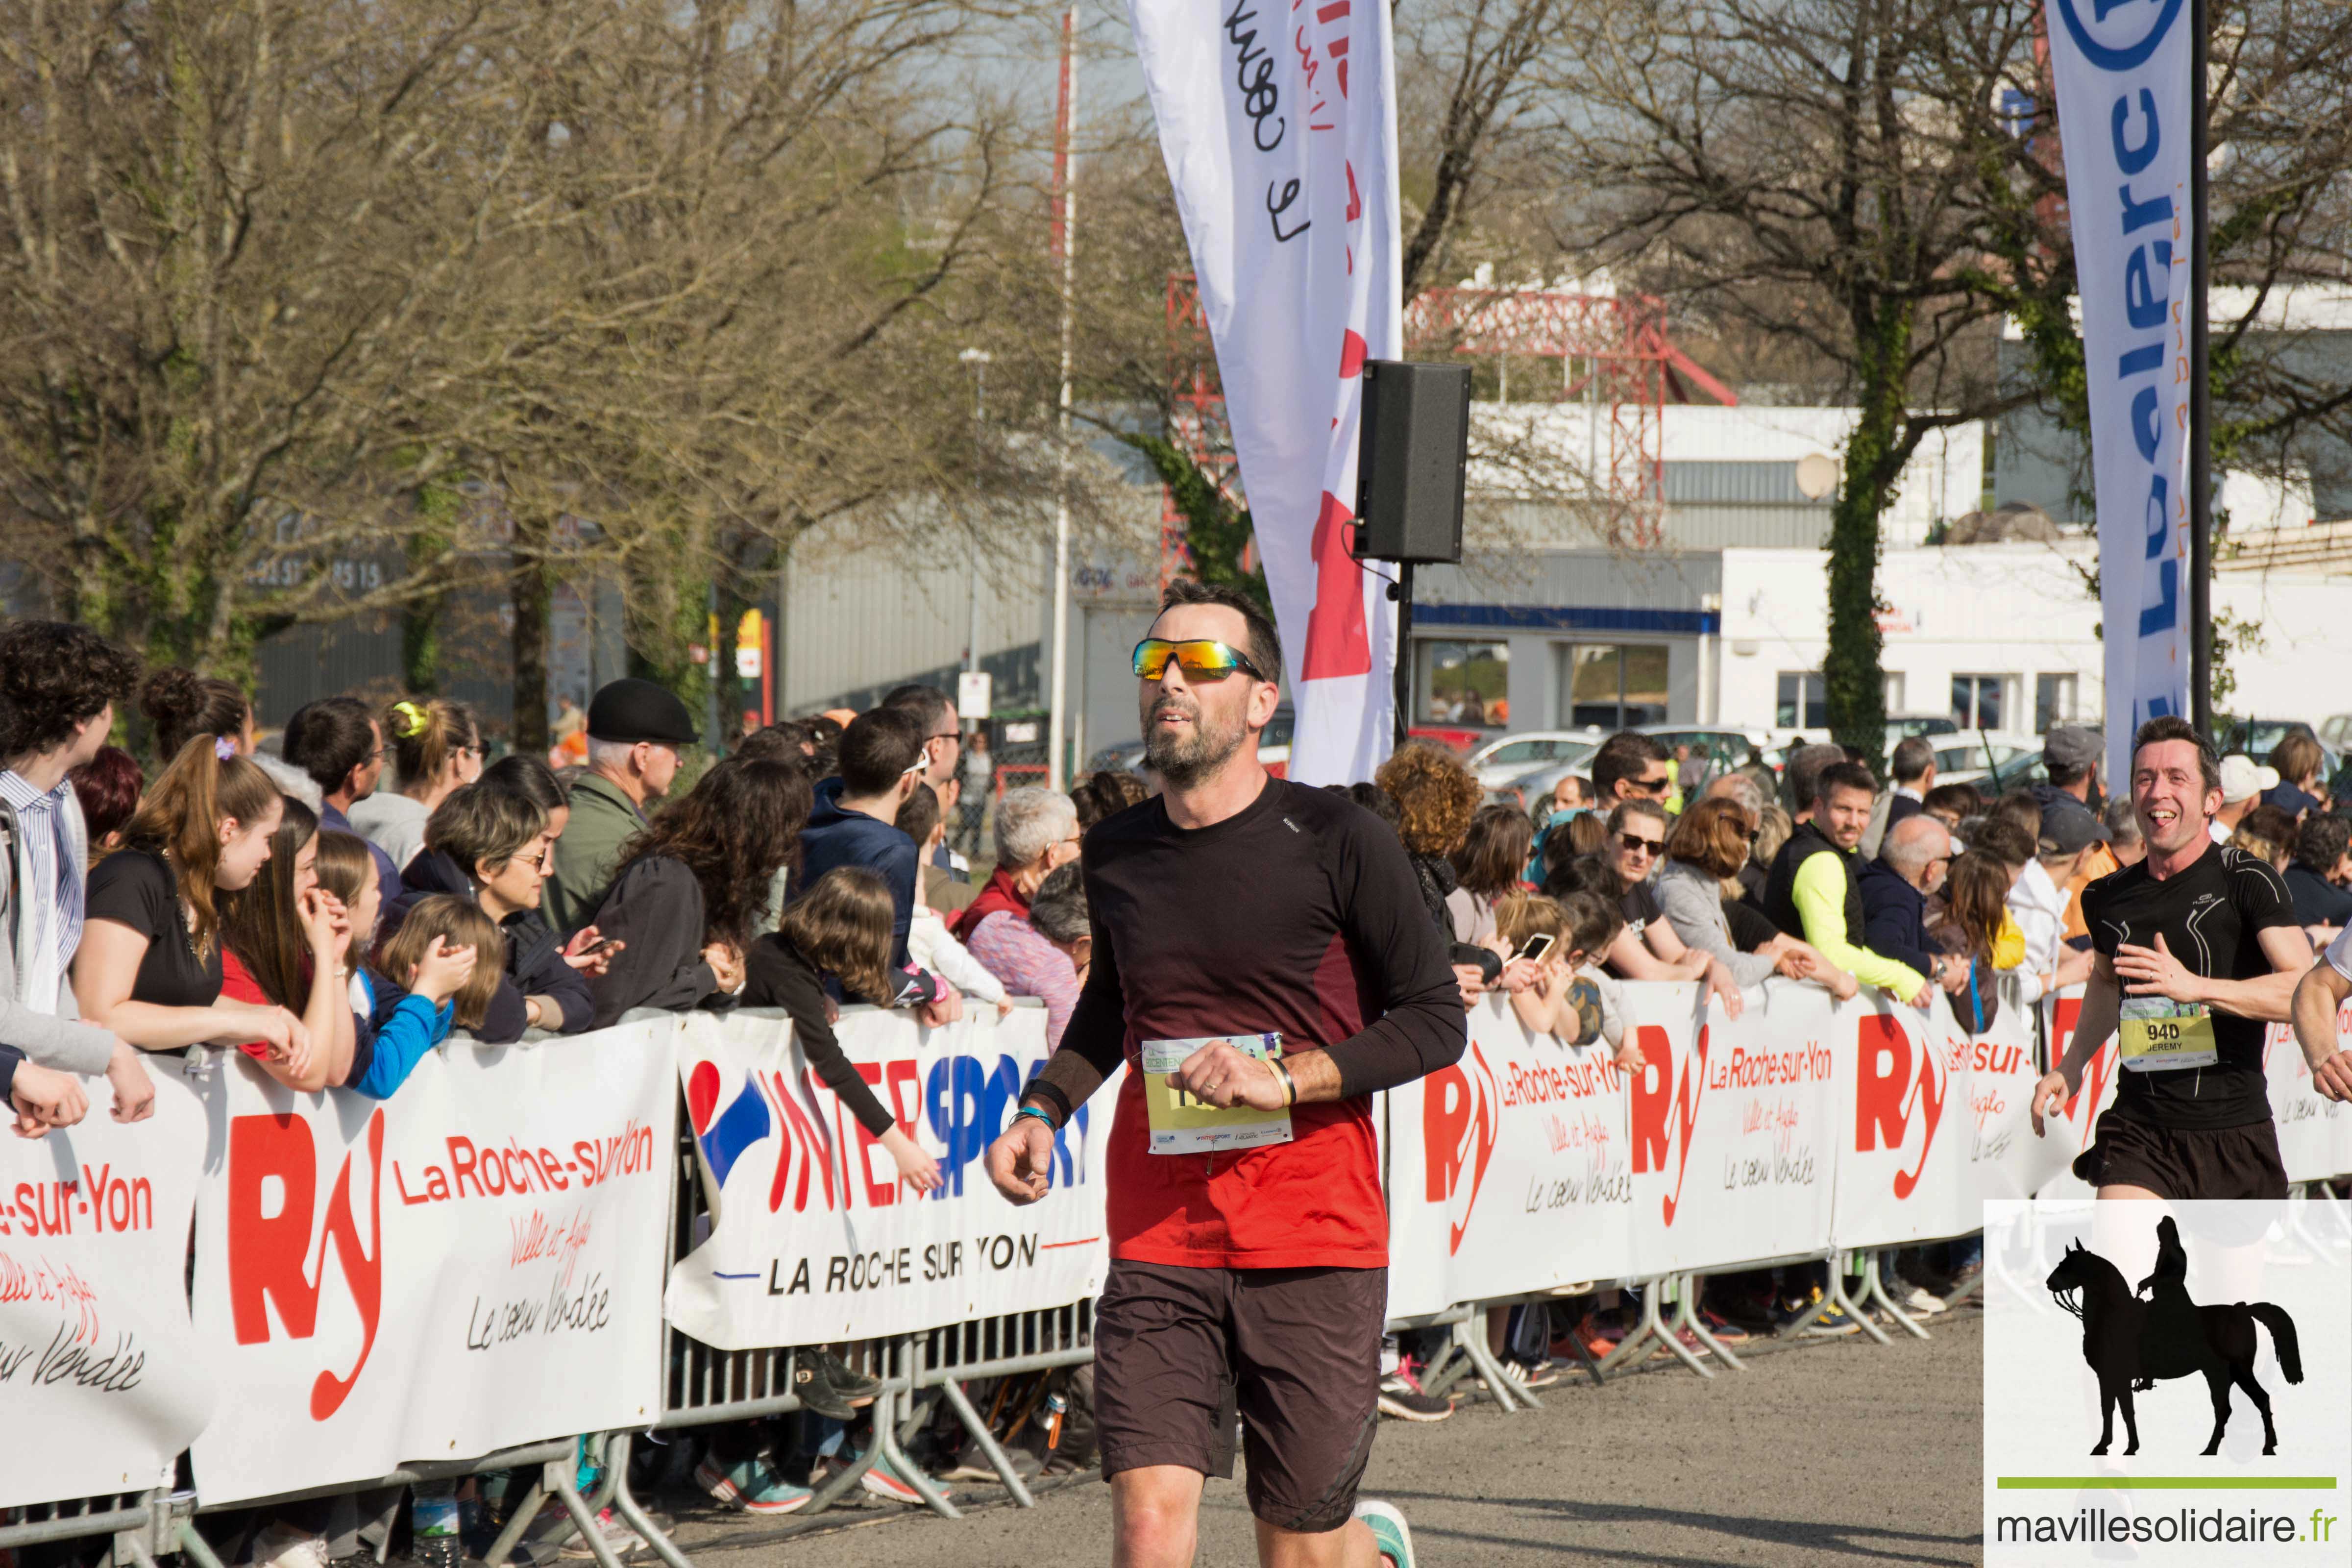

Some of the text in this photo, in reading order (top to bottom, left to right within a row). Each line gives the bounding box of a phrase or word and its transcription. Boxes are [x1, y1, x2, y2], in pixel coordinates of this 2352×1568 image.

[1282, 817, 1299, 833] KIPRUN
[2148, 1024, 2180, 1040] 940
[2147, 1042, 2182, 1052] JEREMY
[768, 1233, 1038, 1295] LA ROCHE SUR YON
